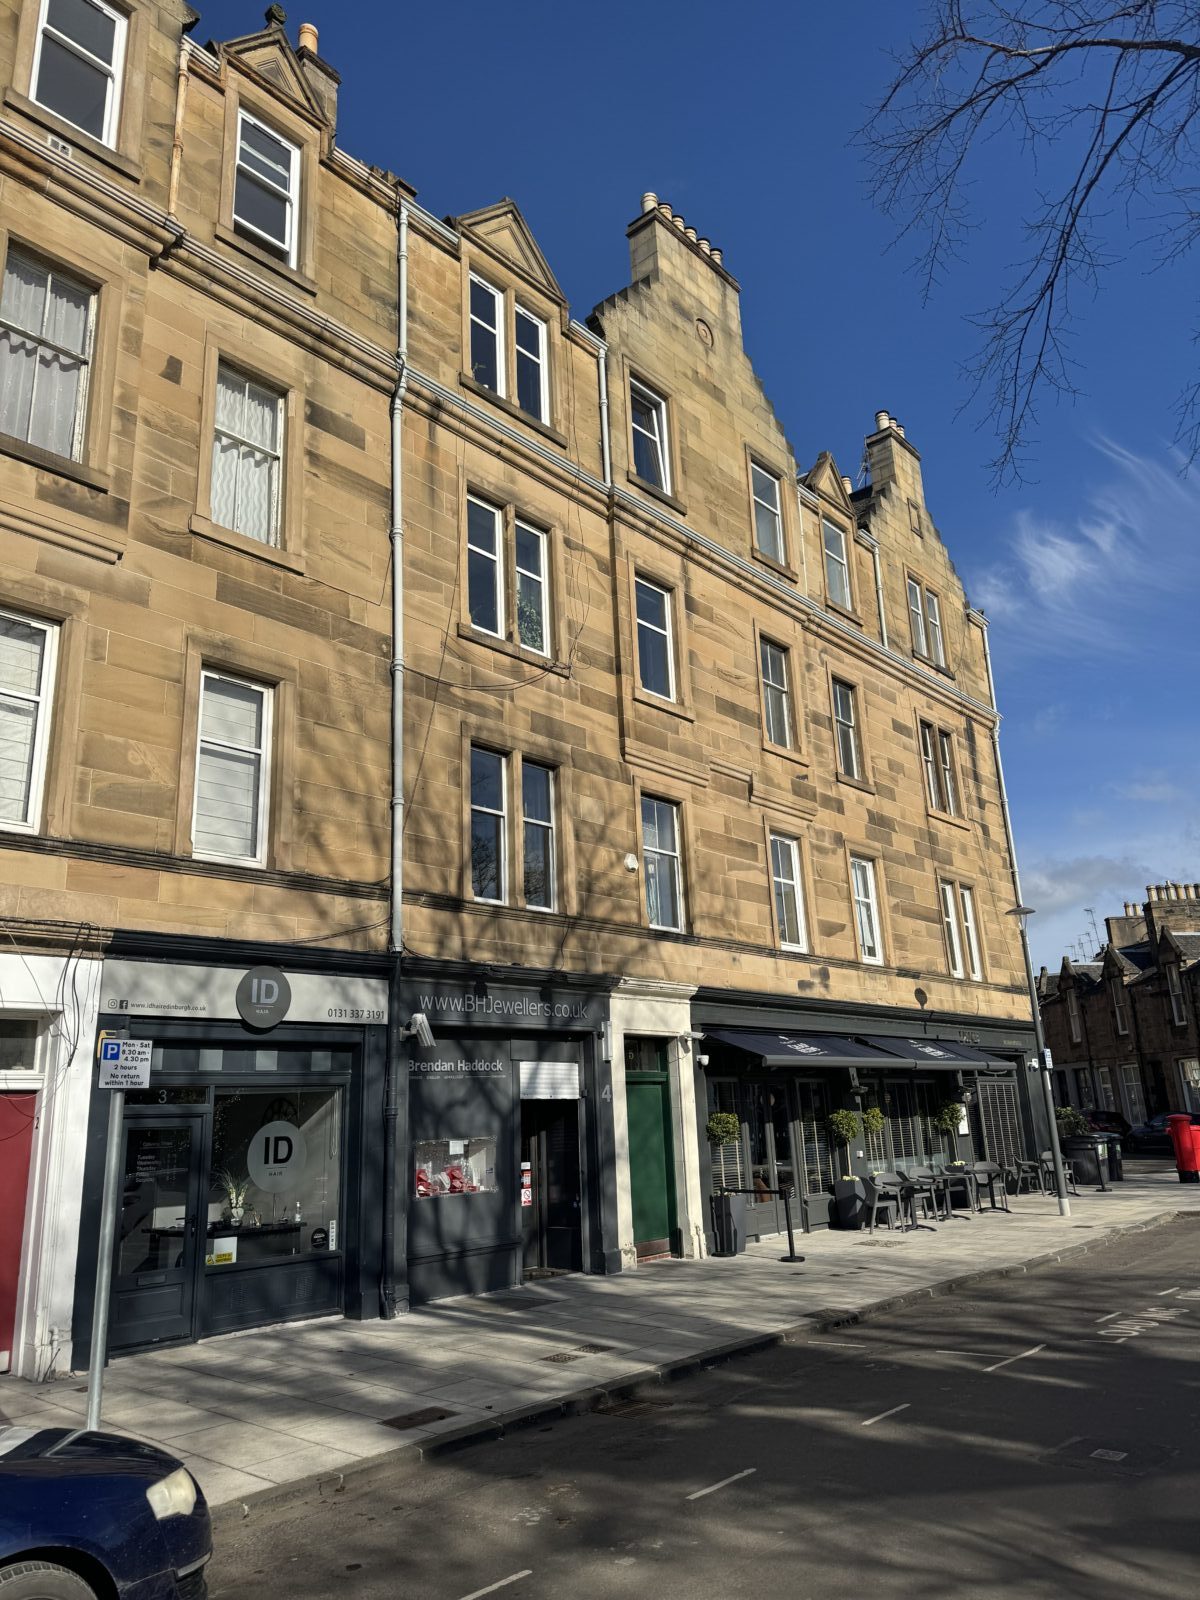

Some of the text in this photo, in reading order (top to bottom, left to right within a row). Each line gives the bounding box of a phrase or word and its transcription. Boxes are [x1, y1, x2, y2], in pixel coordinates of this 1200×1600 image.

[251, 978, 279, 1004] ID
[130, 1001, 207, 1011] www.idhairedinburgh.co.uk
[327, 1008, 385, 1020] 0131 337 3191
[419, 994, 588, 1018] www.BHJewellers.co.uk
[408, 1059, 503, 1072] Brendan Haddock
[158, 1089, 167, 1104] 3
[601, 1084, 612, 1102] 4
[263, 1136, 293, 1165] ID
[1079, 1307, 1190, 1344] LOADING
